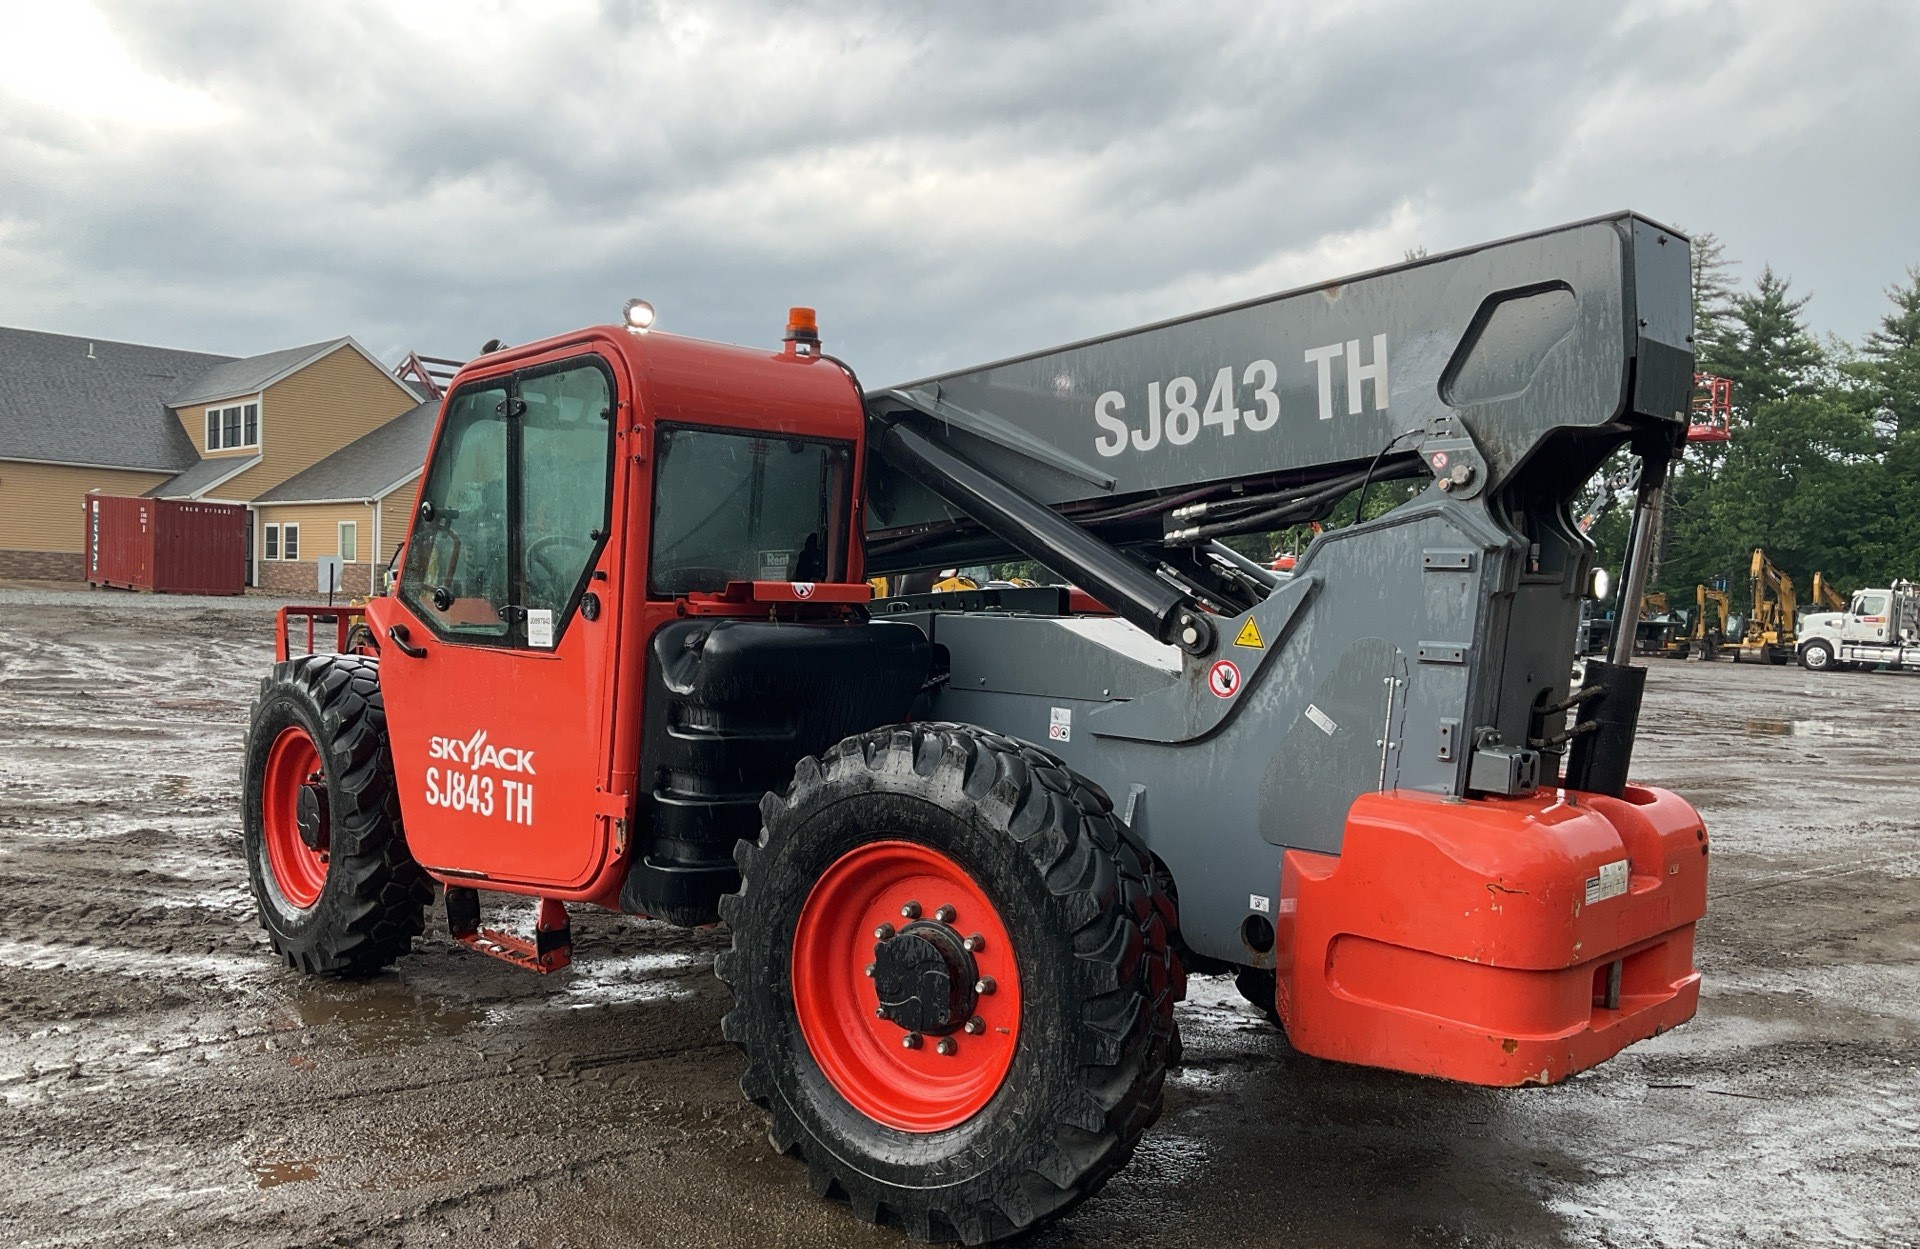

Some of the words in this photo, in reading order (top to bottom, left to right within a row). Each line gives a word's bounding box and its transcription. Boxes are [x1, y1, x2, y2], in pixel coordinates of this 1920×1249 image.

[1094, 359, 1281, 457] SJ843
[1304, 333, 1389, 420] TH
[766, 552, 790, 566] Rent
[428, 728, 537, 775] SKYJACK
[425, 766, 495, 817] SJ843
[502, 779, 533, 826] TH
